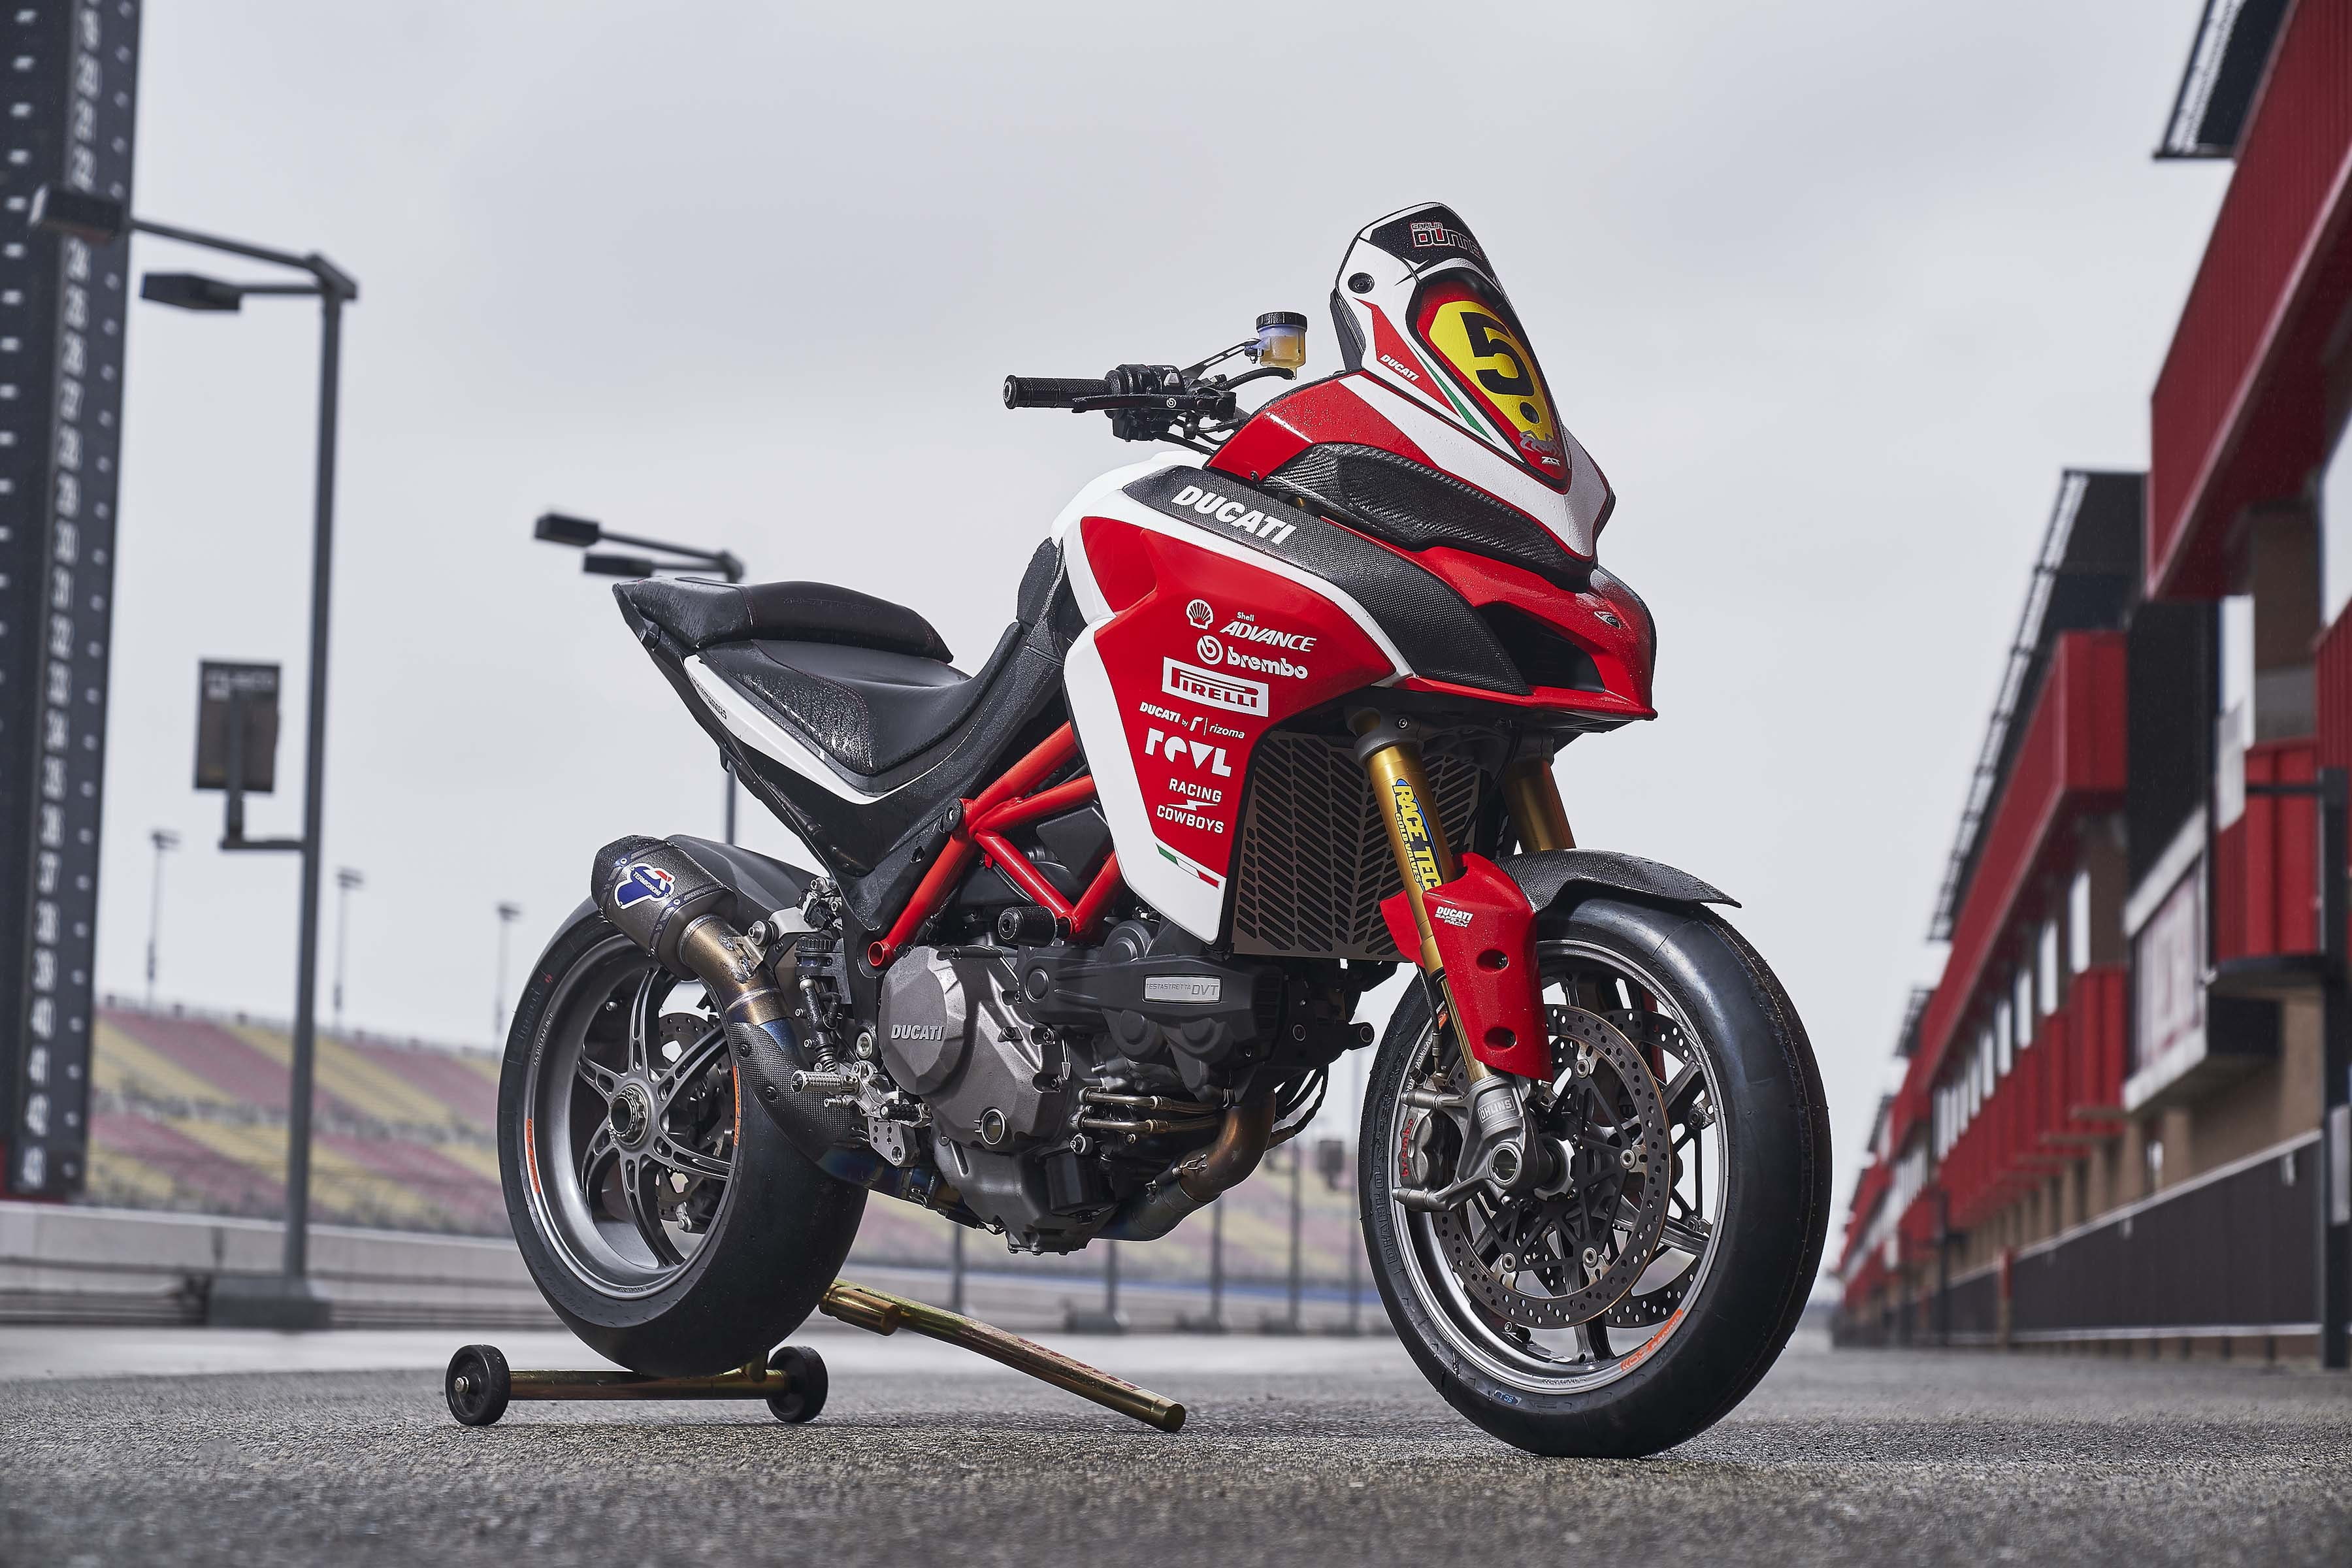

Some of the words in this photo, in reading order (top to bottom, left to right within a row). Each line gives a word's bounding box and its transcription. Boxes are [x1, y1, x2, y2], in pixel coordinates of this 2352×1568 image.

[1379, 353, 1420, 382] DUCATI
[1459, 312, 1534, 397] 5
[1170, 485, 1298, 546] DUCATI
[1237, 612, 1254, 622] Shell
[1220, 620, 1316, 652] ADVANCE
[1228, 646, 1309, 679] brembo
[1171, 668, 1260, 708] PIRELLI
[1139, 701, 1181, 723] DUCATI
[1209, 723, 1245, 739] rizoma
[1168, 777, 1222, 802] RACING
[1156, 804, 1224, 834] COWBOYS
[1393, 785, 1428, 842] RACE
[1414, 846, 1443, 892] TEC
[632, 871, 662, 896] TERMIGNONI
[1436, 906, 1474, 921] DUCATI
[1445, 919, 1469, 928] PACK
[1192, 984, 1219, 996] DVT
[890, 1024, 943, 1041] DUCATI
[1479, 1099, 1513, 1121] ÖHLINS
[1401, 1118, 1415, 1178] brembo
